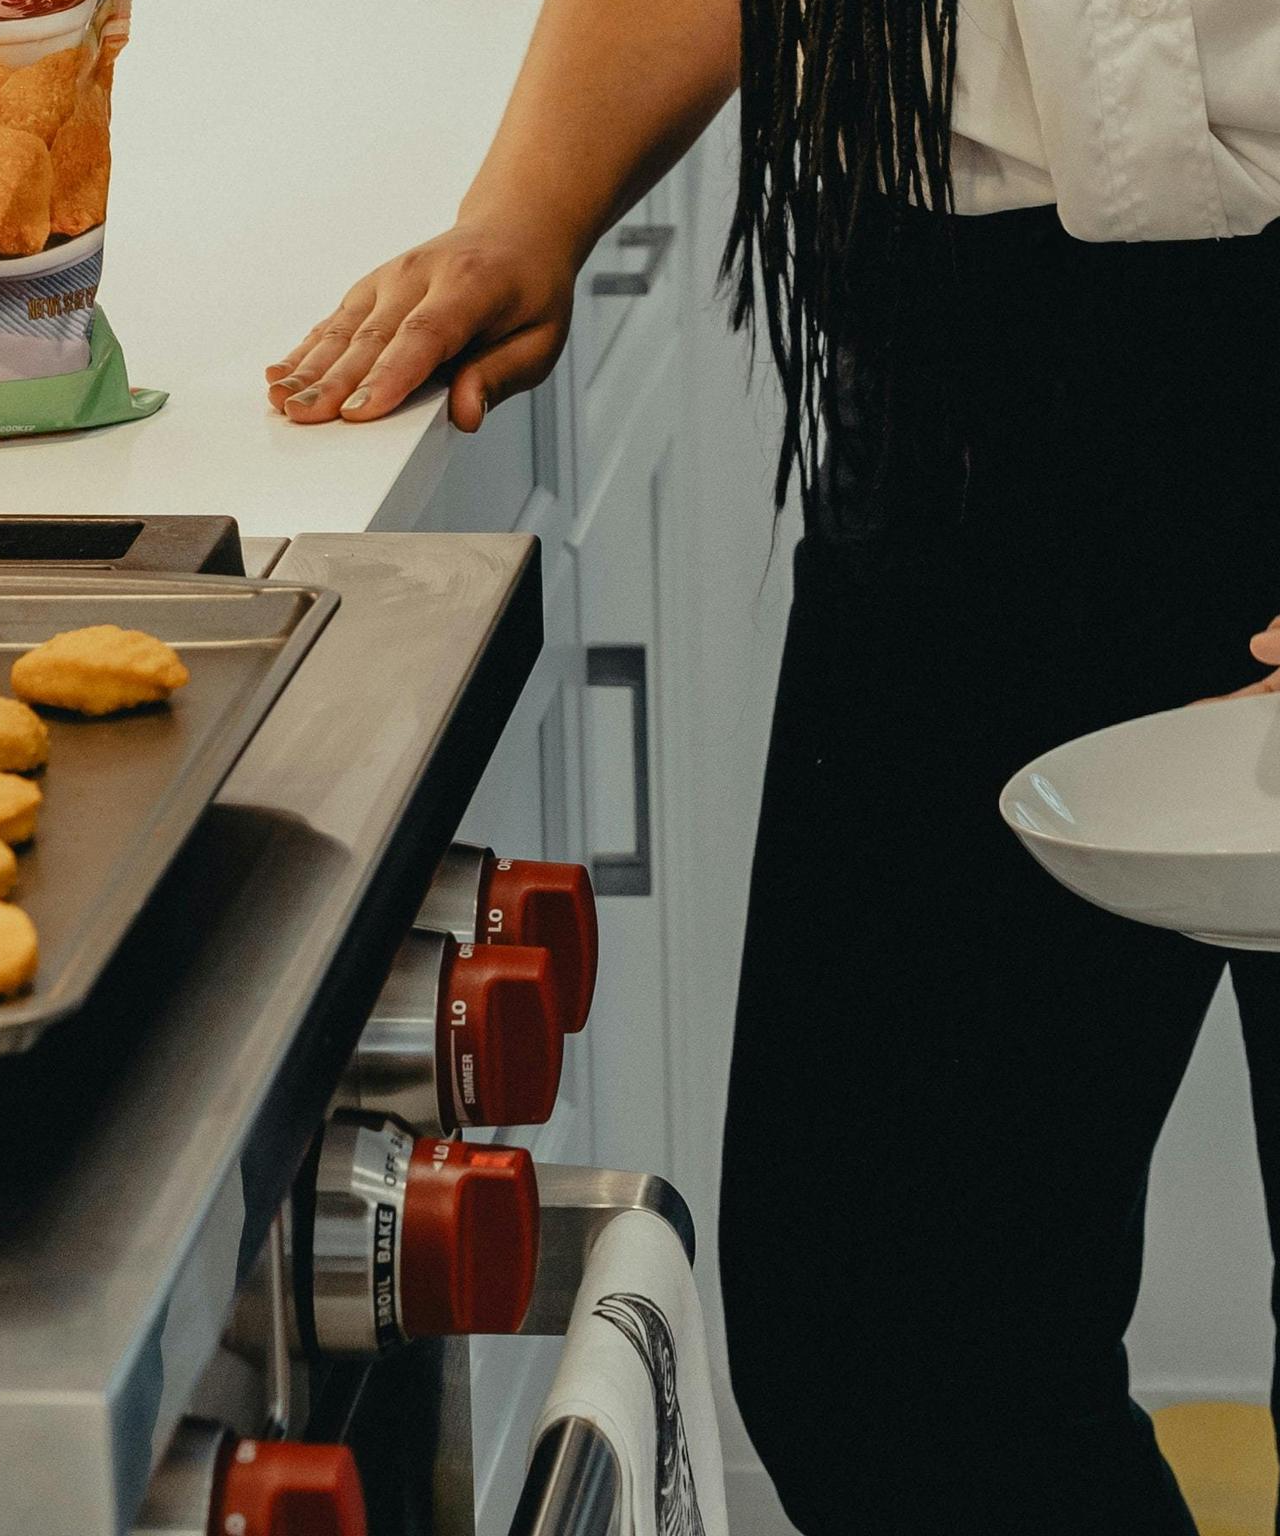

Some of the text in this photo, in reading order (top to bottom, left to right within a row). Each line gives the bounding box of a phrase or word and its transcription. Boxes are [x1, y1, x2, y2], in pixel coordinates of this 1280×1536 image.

[488, 909, 503, 933] LO
[452, 1000, 467, 1026] LO
[462, 1054, 475, 1104] SIMMER
[384, 1152, 396, 1187] OFF
[377, 1209, 393, 1264] BAKE
[377, 1275, 392, 1327] BROIL
